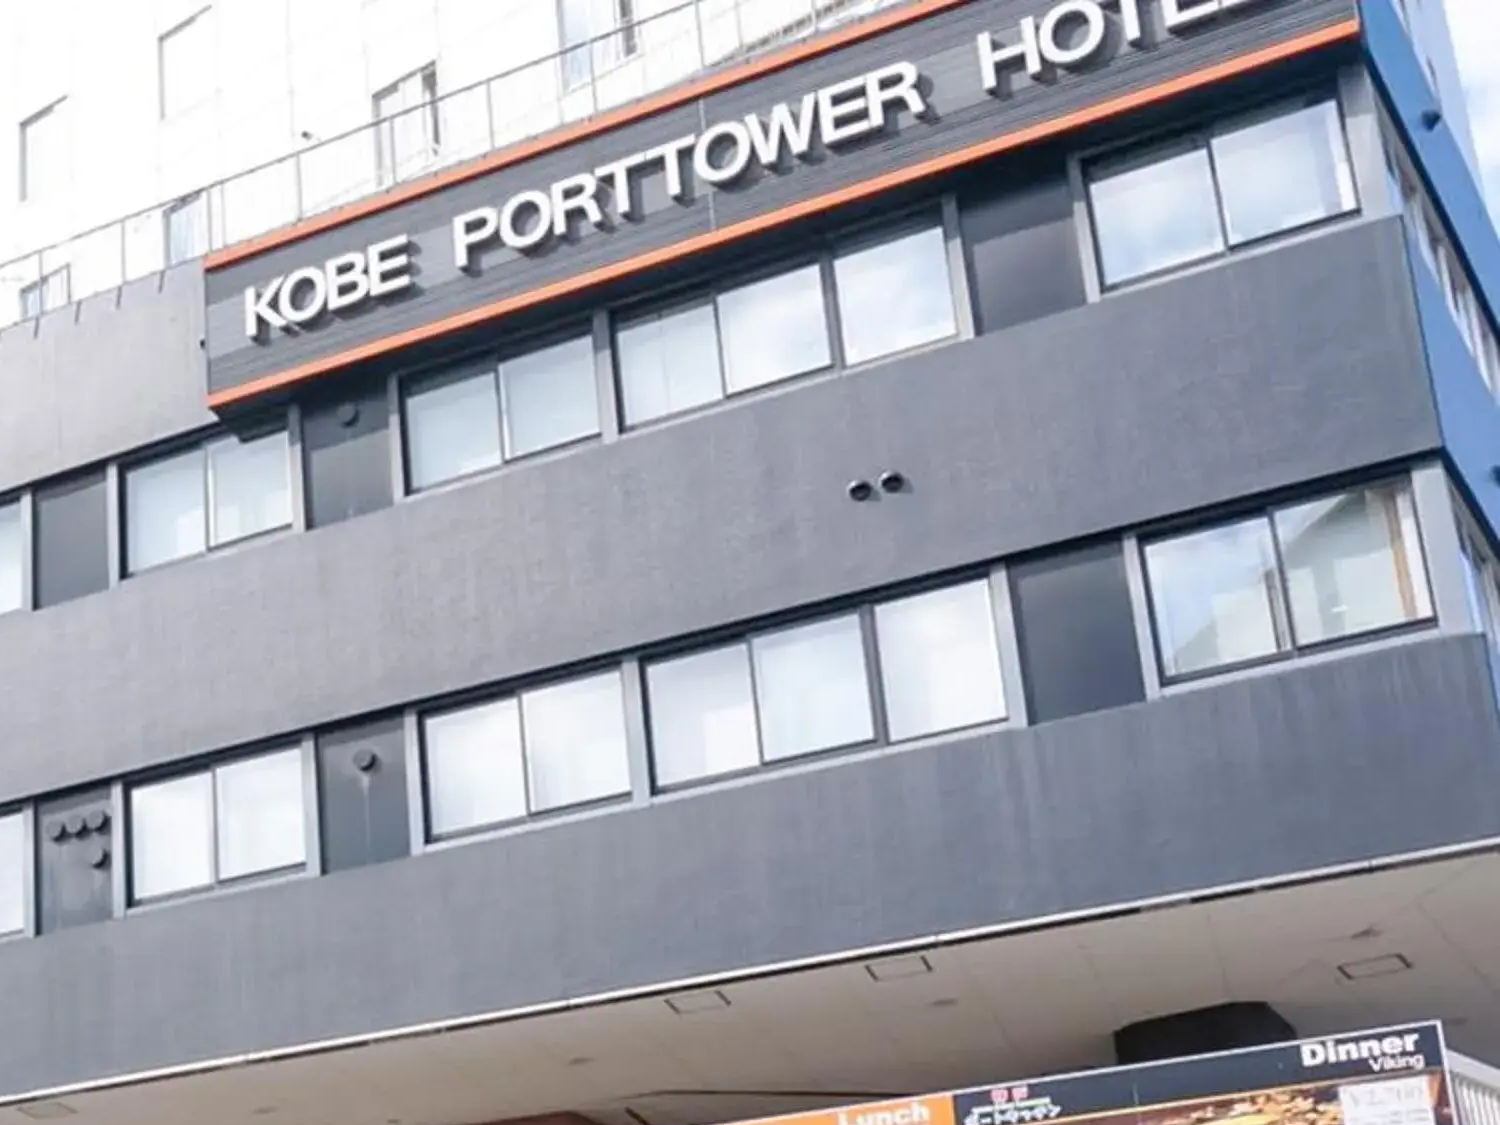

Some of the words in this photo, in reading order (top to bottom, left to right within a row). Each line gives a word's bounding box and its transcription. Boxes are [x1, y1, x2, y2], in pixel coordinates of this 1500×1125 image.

[244, 231, 410, 340] KOBE
[450, 60, 926, 271] PORTTOWER
[976, 0, 1250, 92] HOT
[1300, 1032, 1420, 1067] Dinner
[1368, 1054, 1425, 1073] Viking
